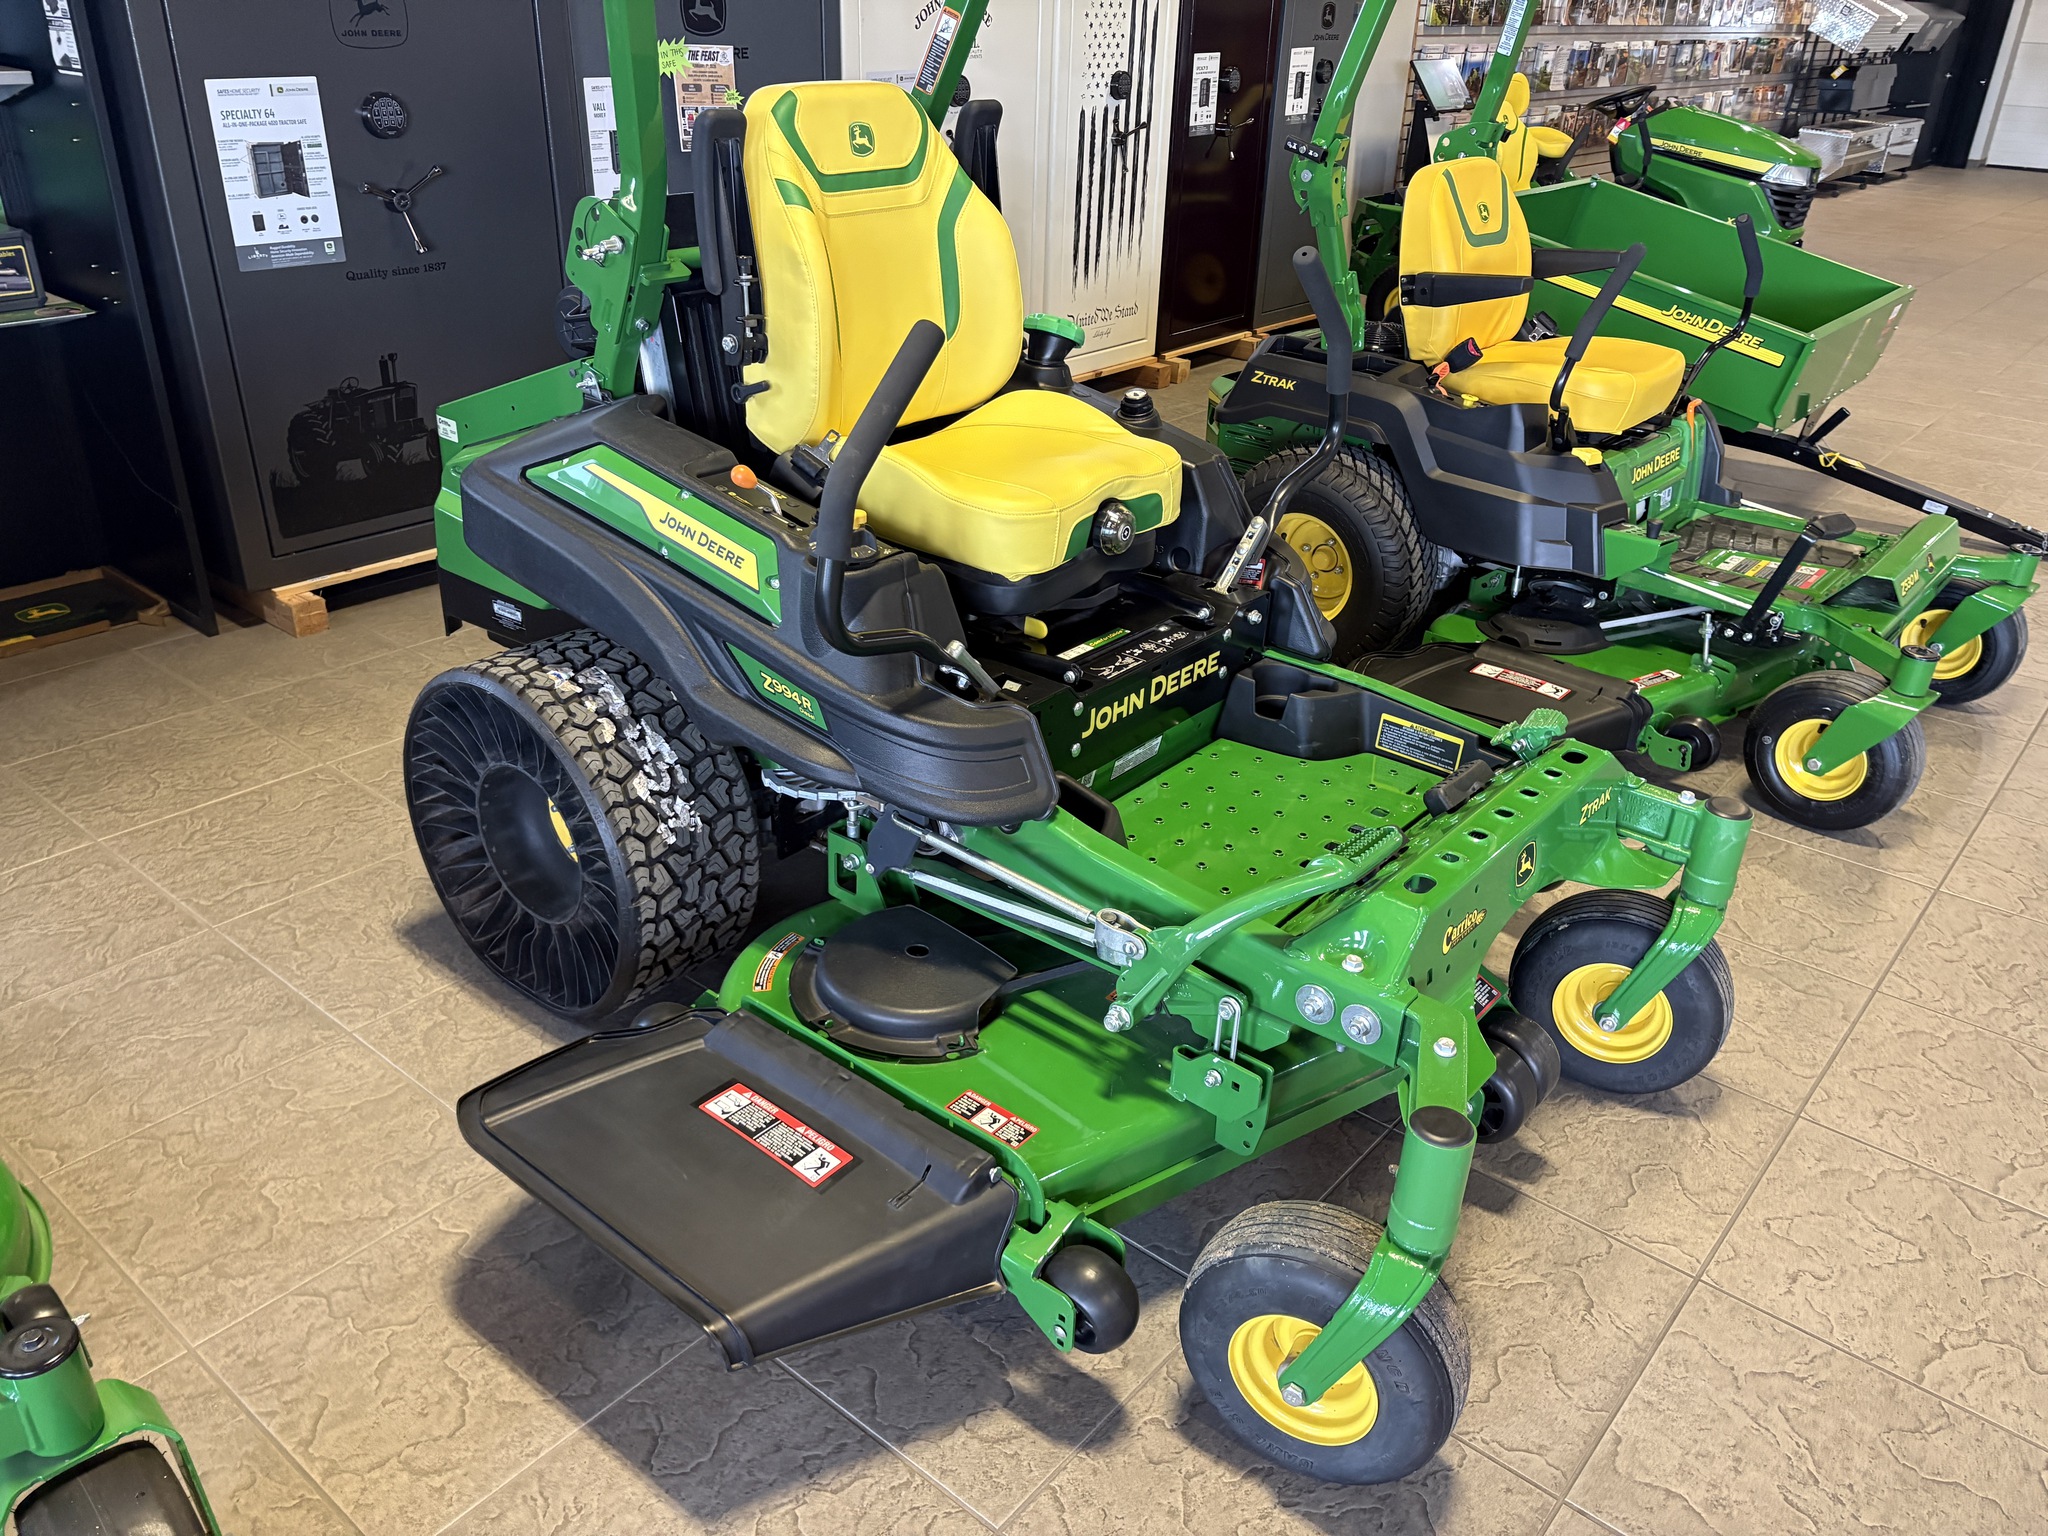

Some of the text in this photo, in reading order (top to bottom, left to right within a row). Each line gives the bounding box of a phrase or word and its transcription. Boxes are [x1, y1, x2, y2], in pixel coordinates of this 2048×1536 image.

[341, 29, 402, 37] JOHN DEERE
[1325, 33, 1340, 41] DEERE
[660, 47, 684, 59] IN THIS
[687, 50, 699, 61] THE
[700, 50, 720, 62] FEAST
[661, 60, 677, 69] SAFE
[220, 108, 275, 121] SPECIALTY 64
[222, 120, 268, 128] ALL-IN-ONE-PACKAGE
[1660, 140, 1703, 157] JOHN DEERE
[345, 261, 447, 281] Quality since 1837
[1096, 306, 1113, 322] We
[1114, 300, 1139, 319] Stand
[1661, 304, 1765, 349] JOHN DERE
[1250, 370, 1297, 391] ZTRAK
[1631, 446, 1681, 485] JOHN DEERE
[659, 511, 745, 570] JOHN DEERE
[760, 671, 813, 713] Z994R
[1081, 650, 1221, 739] JOHN DEERE
[1579, 785, 1613, 826] ZTRAK
[1442, 909, 1478, 955] Carrico
[751, 1095, 779, 1115] DANGER
[970, 1092, 992, 1107] DANGER
[1015, 1117, 1038, 1133] PELIGRO
[804, 1128, 835, 1151] PELIGRO
